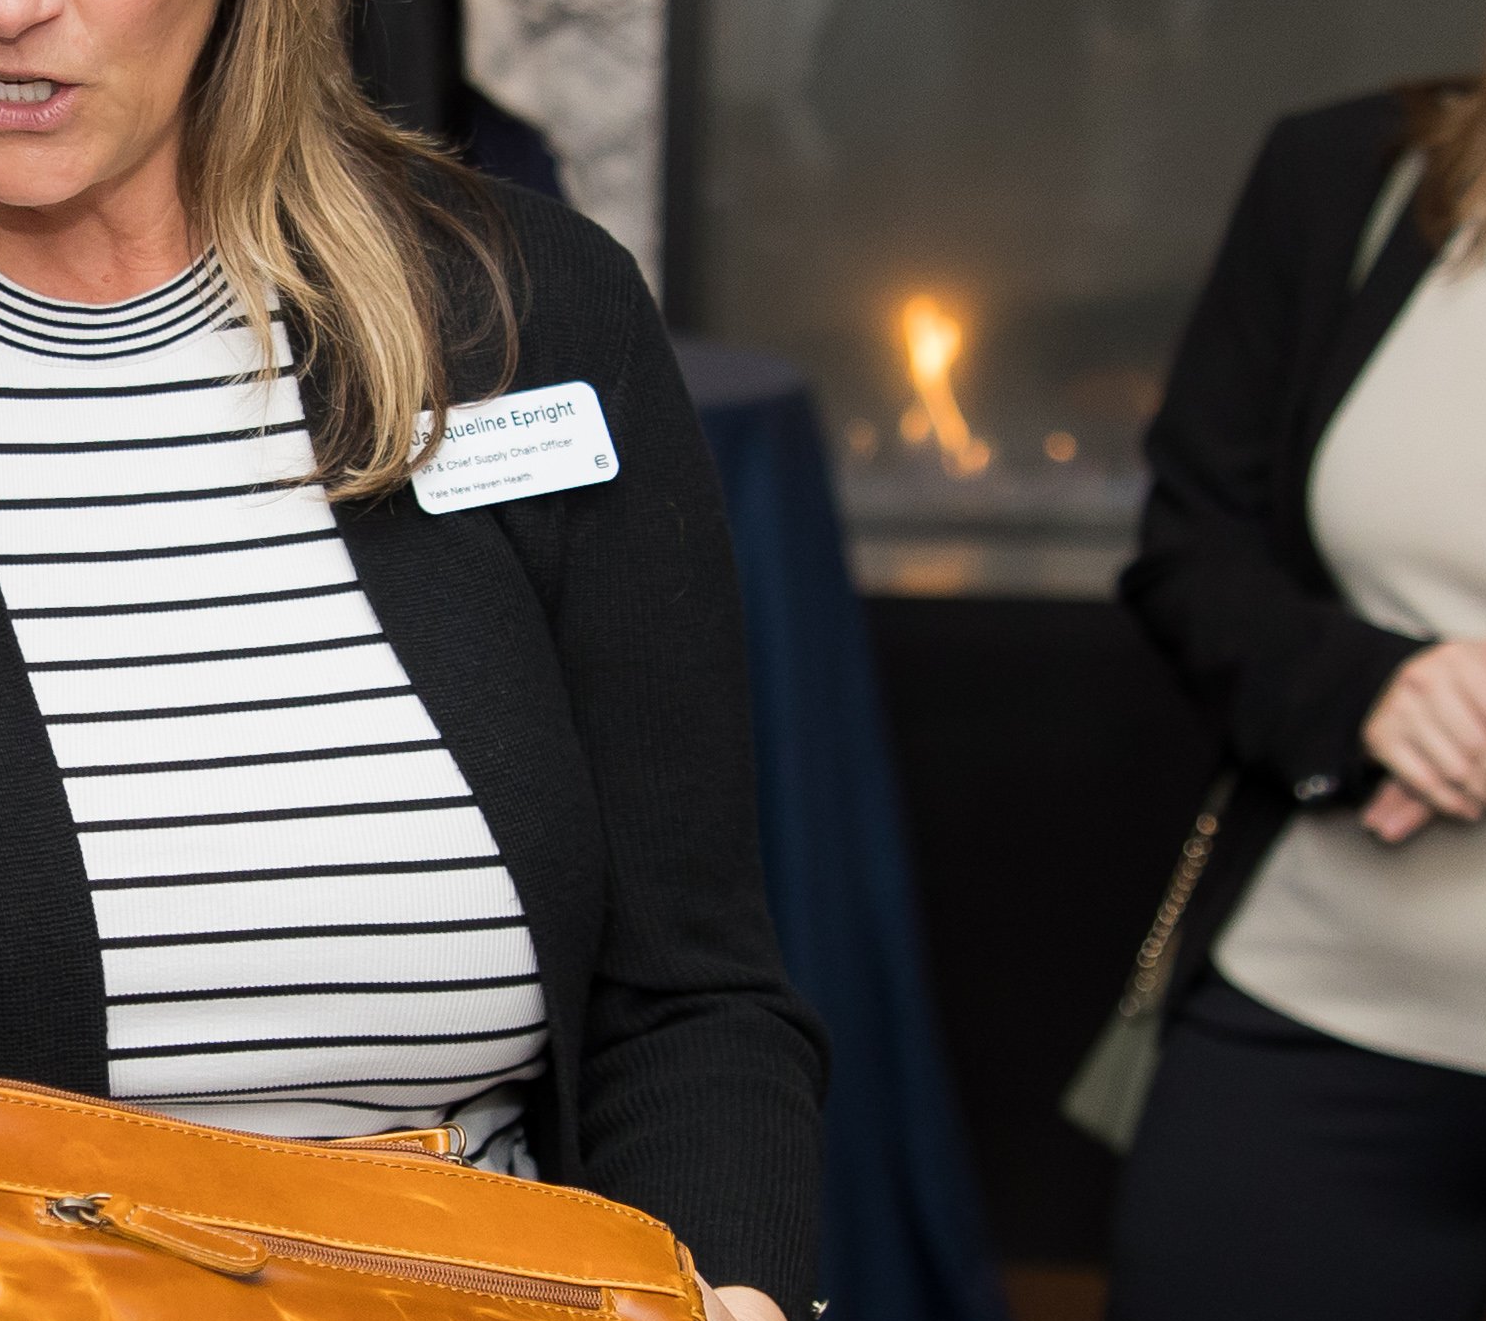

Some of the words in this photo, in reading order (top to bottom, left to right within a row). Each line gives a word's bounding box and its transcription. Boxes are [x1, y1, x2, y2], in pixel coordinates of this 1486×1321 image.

[411, 416, 507, 446] Jaqueline
[511, 401, 576, 428] Epright
[446, 457, 471, 470] Chief
[475, 451, 507, 465] Supply
[510, 445, 538, 458] Chain
[540, 438, 573, 451] Officer
[428, 490, 449, 500] Yale
[450, 485, 471, 495] New
[473, 479, 502, 490] Haven
[503, 472, 534, 484] Health
